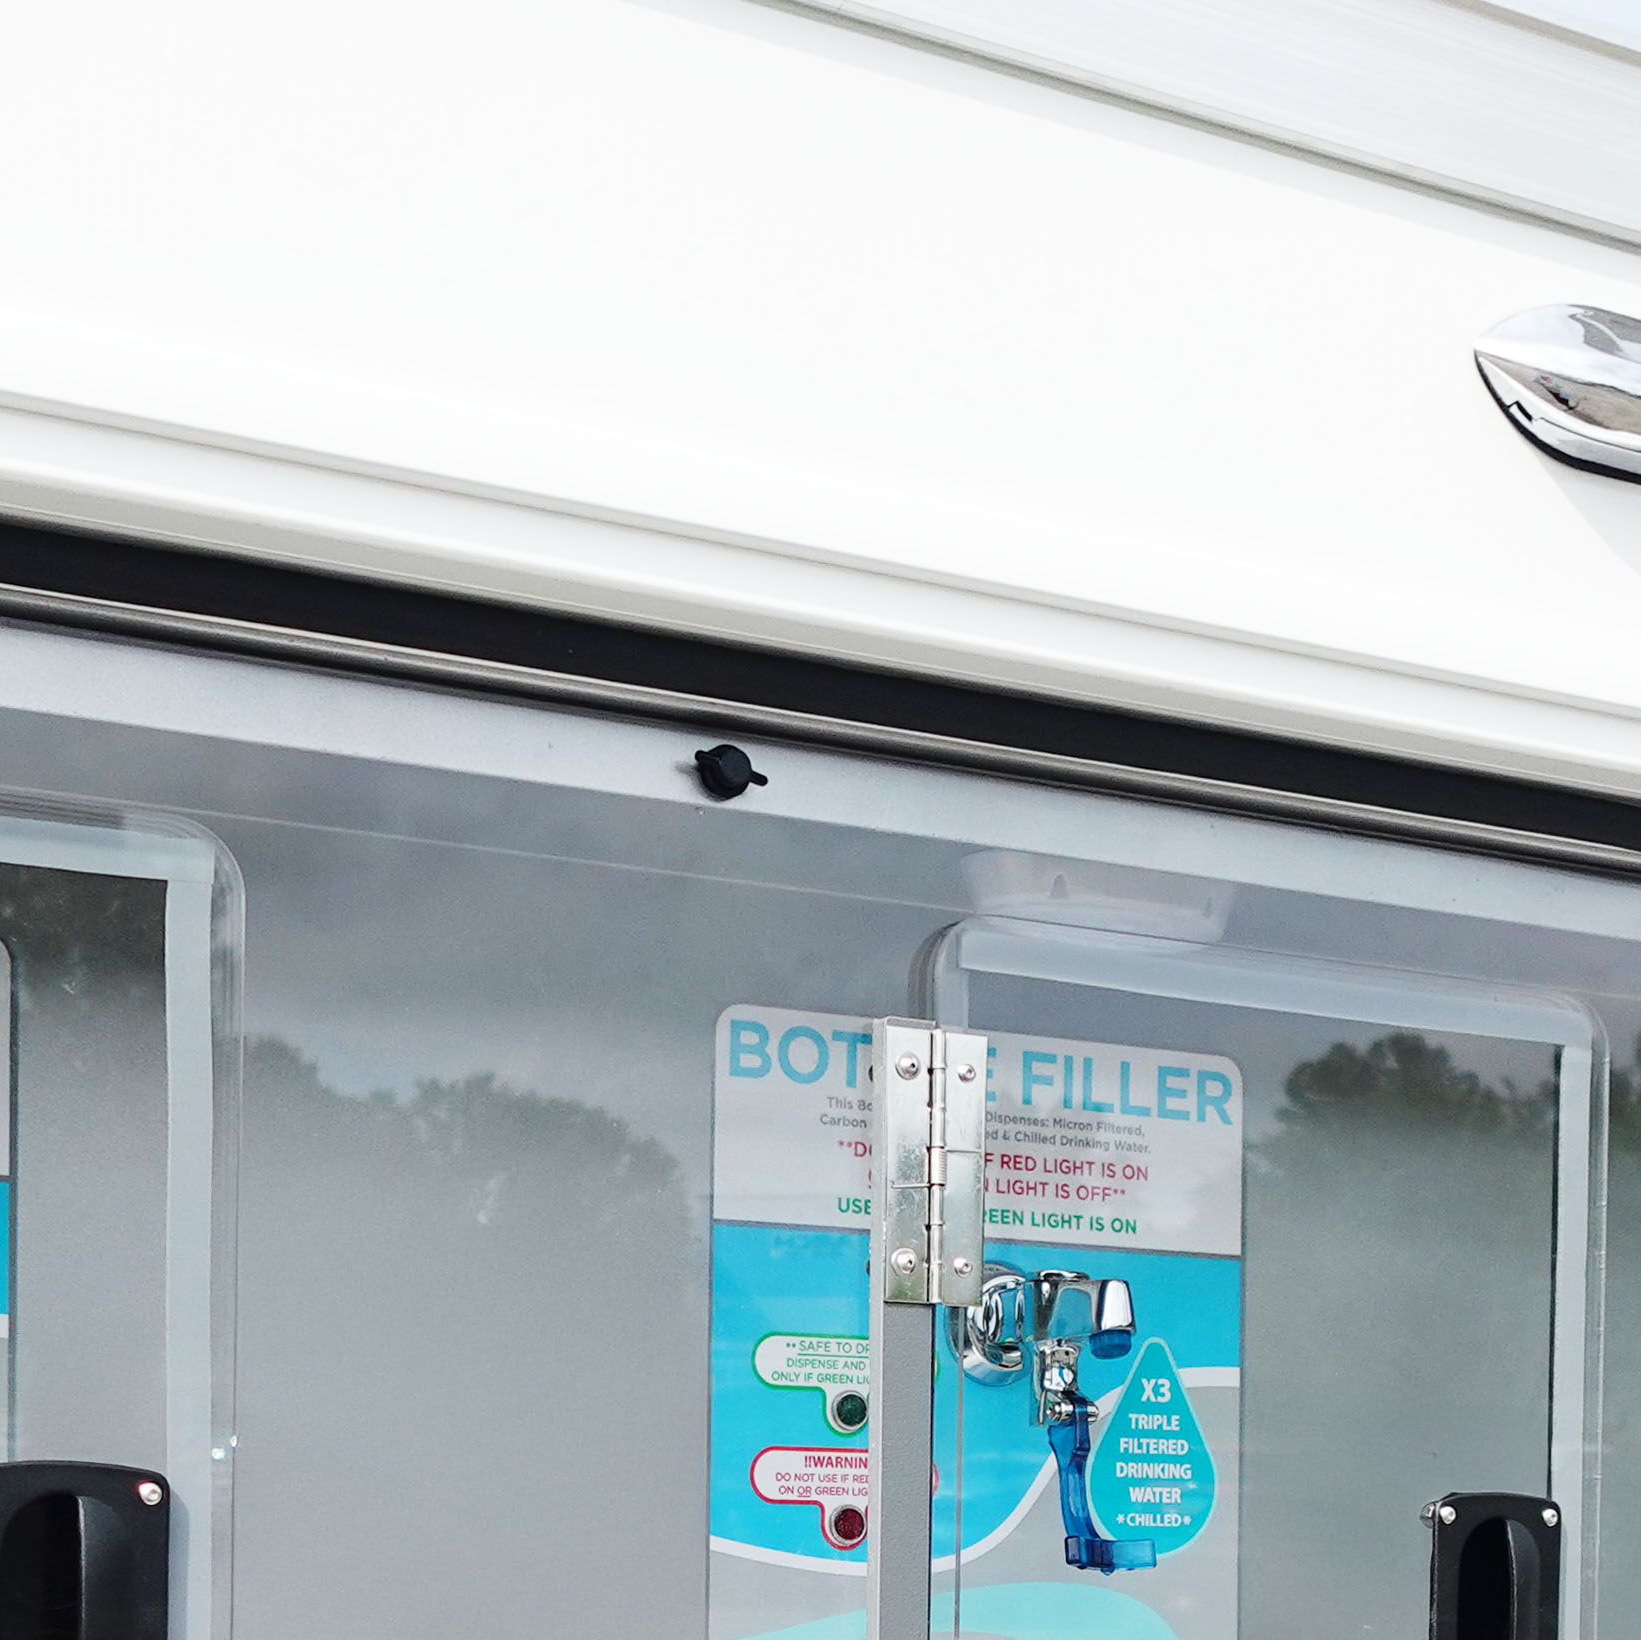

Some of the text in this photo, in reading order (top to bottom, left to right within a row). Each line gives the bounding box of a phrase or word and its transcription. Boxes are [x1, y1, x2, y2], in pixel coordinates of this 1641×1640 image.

[1022, 1051, 1232, 1125] FILLER
[827, 1096, 852, 1110] This
[1053, 1117, 1092, 1131] Micron
[1097, 1121, 1145, 1138] Filtered,
[819, 1113, 1151, 1153] Carbon & Chilled Drinking Water.
[1000, 1153, 1036, 1172] RED
[1043, 1157, 1095, 1176] LIGHT
[1101, 1161, 1116, 1178] IS
[1122, 1163, 1148, 1181] ON
[996, 1177, 1048, 1197] LIGHT
[1055, 1182, 1070, 1199] IS
[1030, 1211, 1083, 1230] LIGHT
[1089, 1215, 1104, 1231] IS
[1111, 1216, 1136, 1234] ON
[835, 1341, 851, 1354] TO
[786, 1357, 865, 1371] DISPENSE AND
[771, 1371, 800, 1382] ONLY
[804, 1373, 813, 1383] IF
[817, 1373, 853, 1384] GREEN
[1140, 1377, 1170, 1403] X3
[1128, 1413, 1180, 1430] TRIPLE
[1119, 1438, 1188, 1455] FILTERED
[776, 1473, 849, 1484] DO NOT USE IF
[1116, 1462, 1191, 1479] DRINKING
[779, 1486, 793, 1496] ON
[797, 1486, 811, 1498] OR
[815, 1487, 849, 1497] GREEN
[1129, 1487, 1181, 1503] WATER
